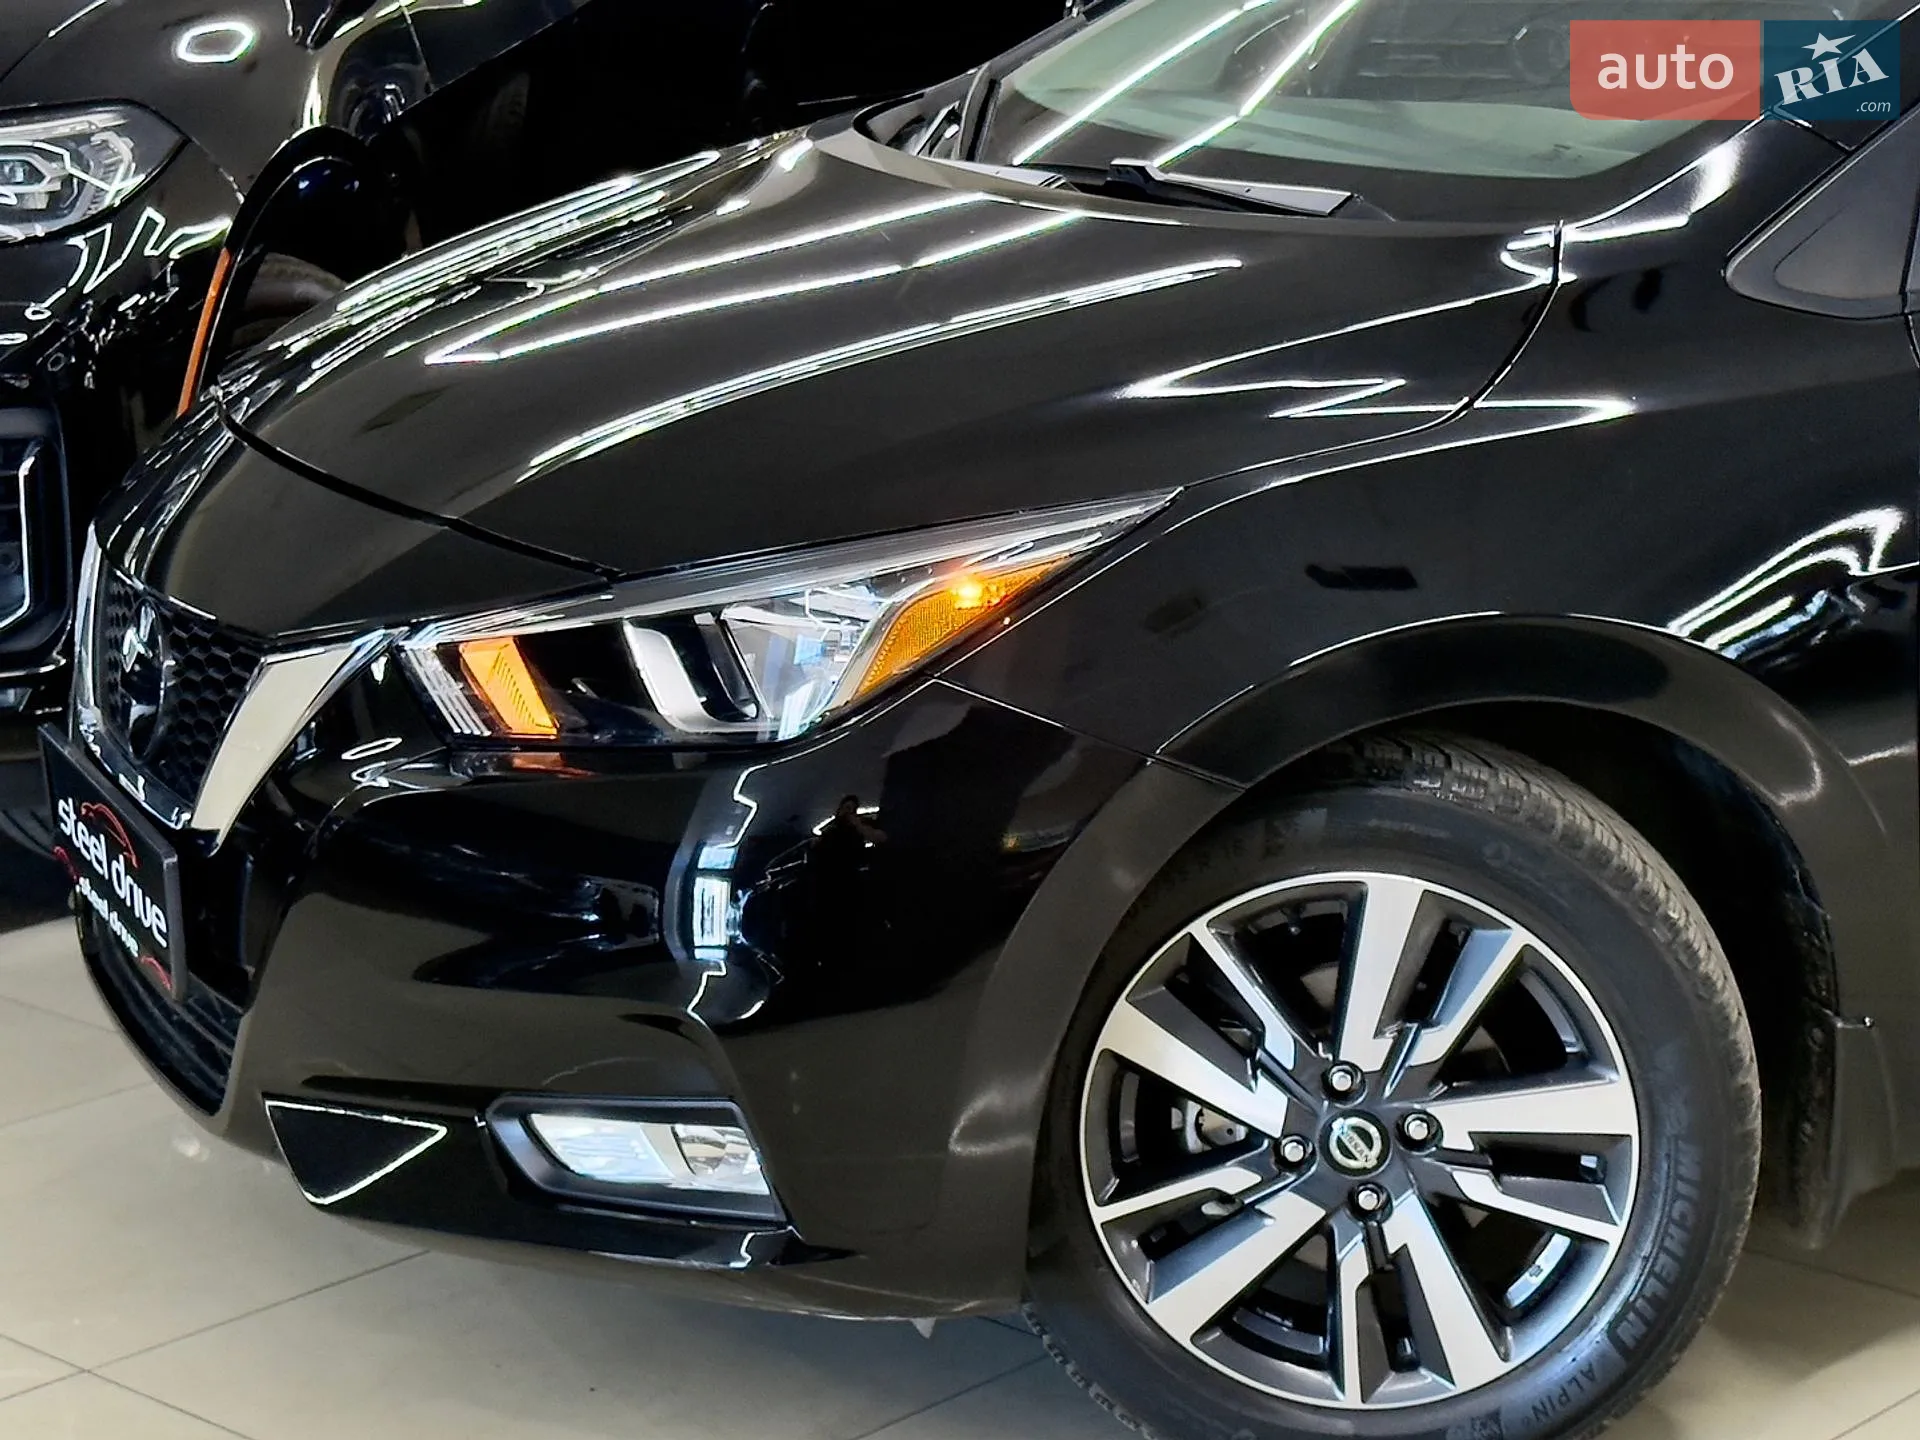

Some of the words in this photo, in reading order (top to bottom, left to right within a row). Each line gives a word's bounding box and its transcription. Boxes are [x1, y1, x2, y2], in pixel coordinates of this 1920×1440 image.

[57, 797, 109, 880] steel
[110, 854, 168, 949] drive
[1614, 1138, 1703, 1350] MICHELIN
[1530, 1358, 1599, 1425] ALPIN
